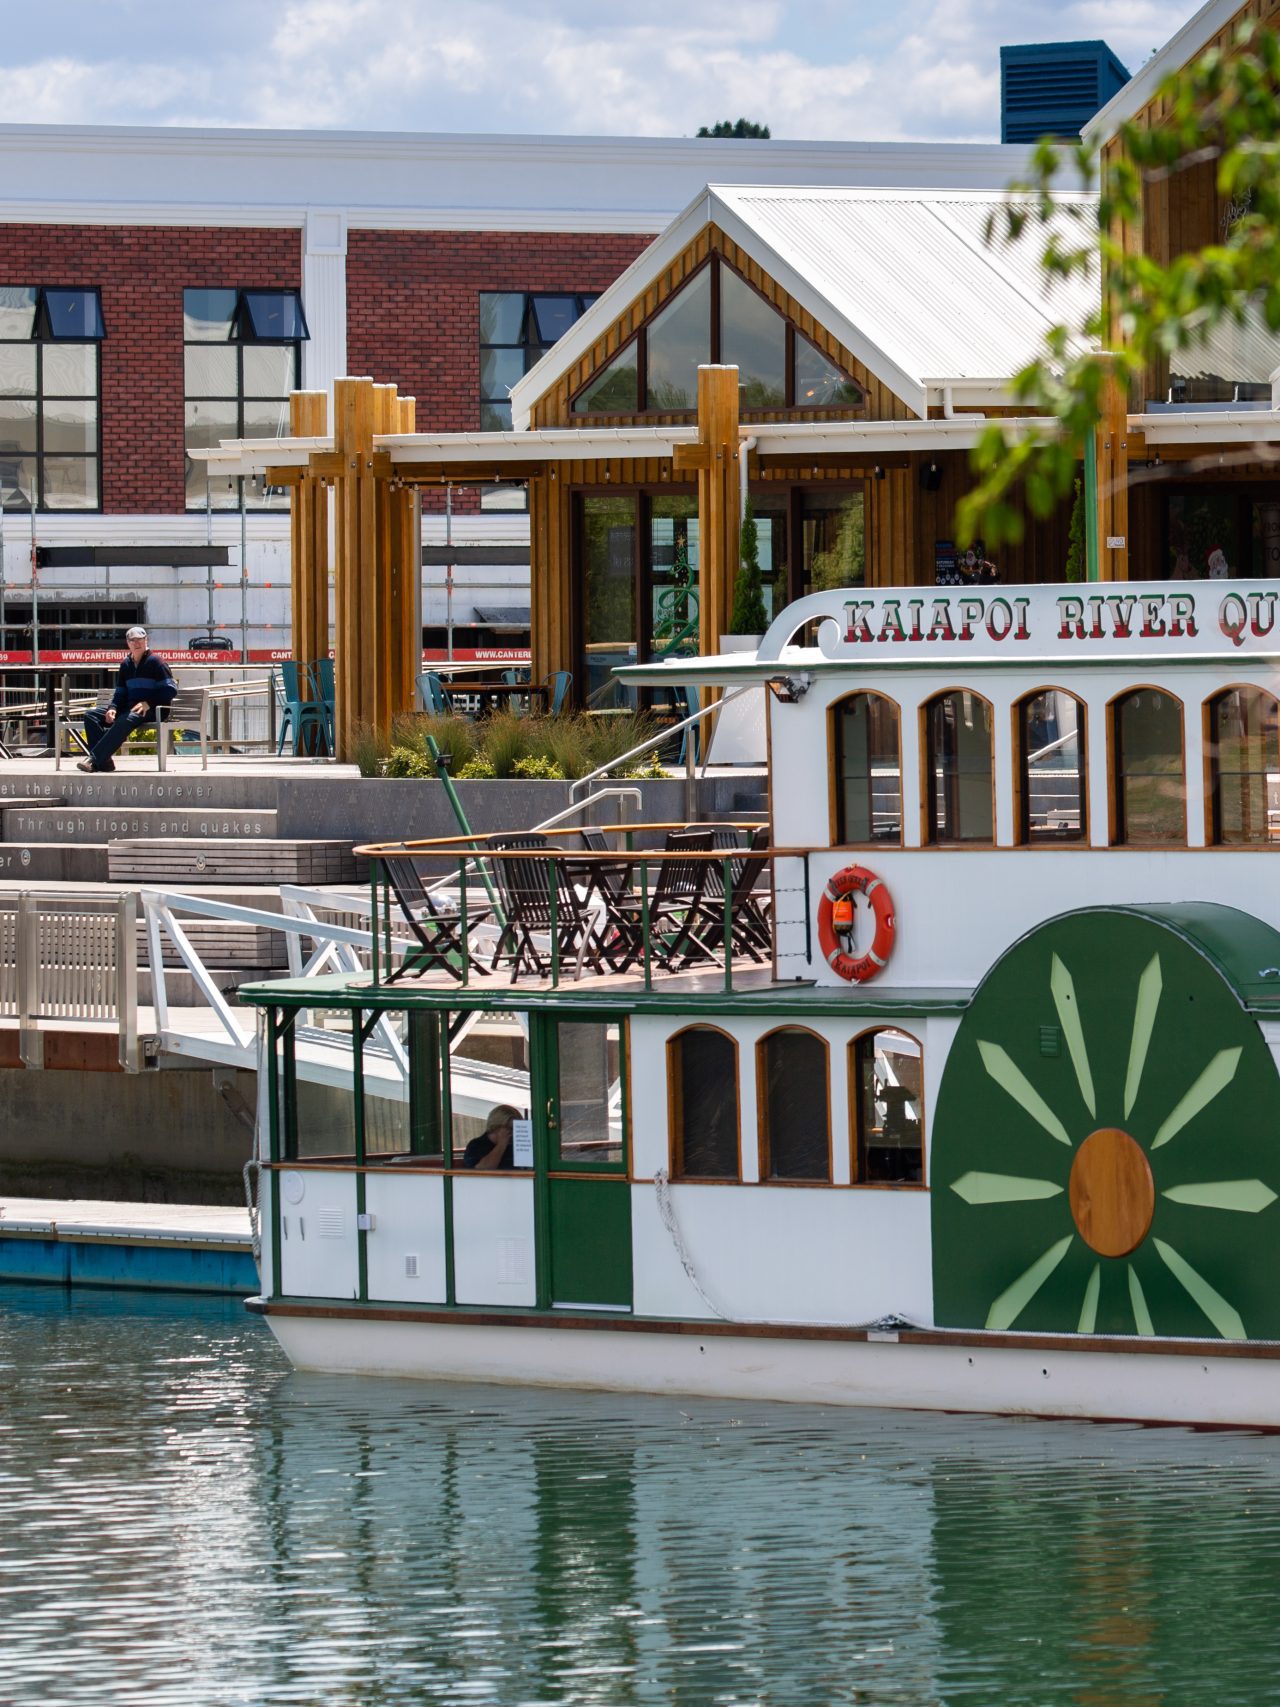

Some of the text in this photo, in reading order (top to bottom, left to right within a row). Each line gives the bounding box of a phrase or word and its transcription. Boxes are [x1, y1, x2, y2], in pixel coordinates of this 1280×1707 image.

[843, 597, 1031, 643] KAIAPOI
[1056, 595, 1199, 639] RIVER
[0, 782, 213, 797] et the river run forever
[95, 819, 149, 832] floods
[160, 819, 189, 833] and
[200, 819, 262, 835] quakes
